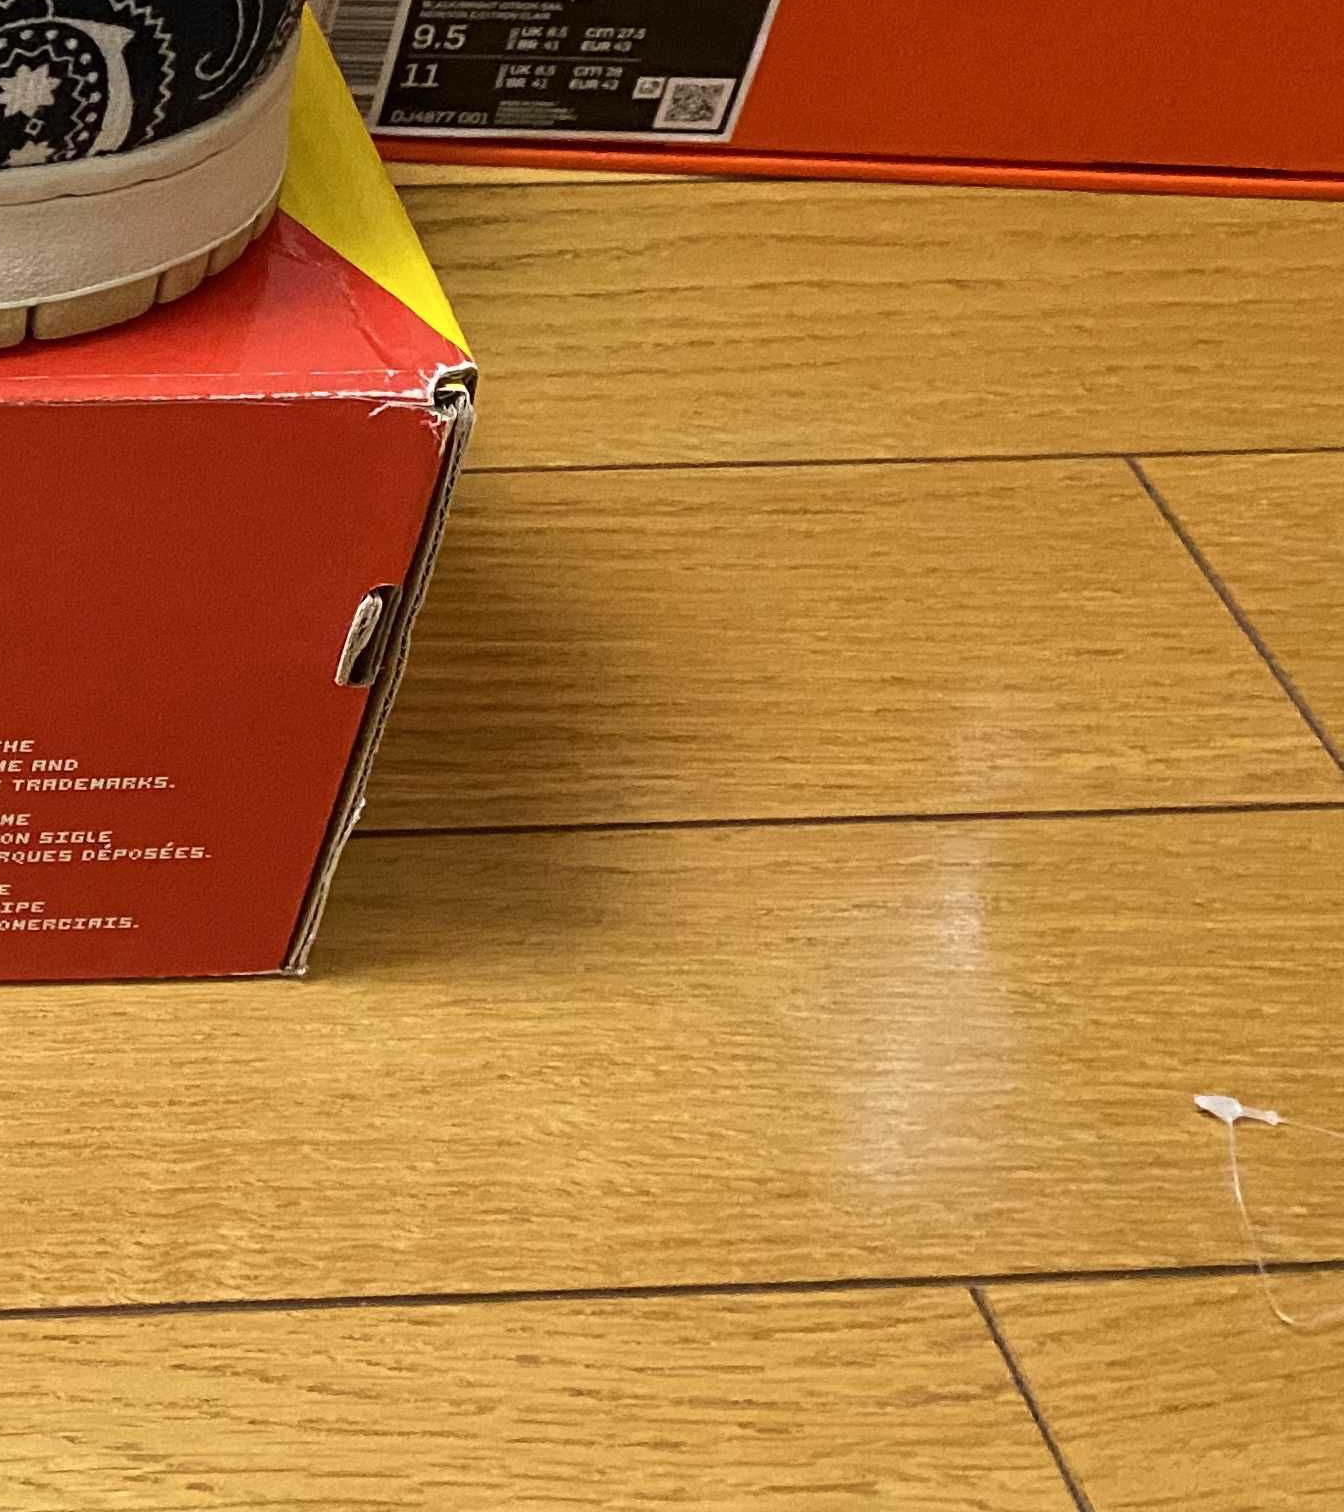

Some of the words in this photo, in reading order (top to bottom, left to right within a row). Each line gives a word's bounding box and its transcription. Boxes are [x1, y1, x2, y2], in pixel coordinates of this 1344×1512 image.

[411, 23, 469, 51] 9.5
[580, 40, 612, 53] EUR
[400, 63, 440, 88] 11
[31, 758, 79, 772] AND
[12, 775, 176, 792] TRADEMARKS.
[38, 830, 113, 844] SIGLE
[81, 841, 212, 862] DÉPOSÉES.
